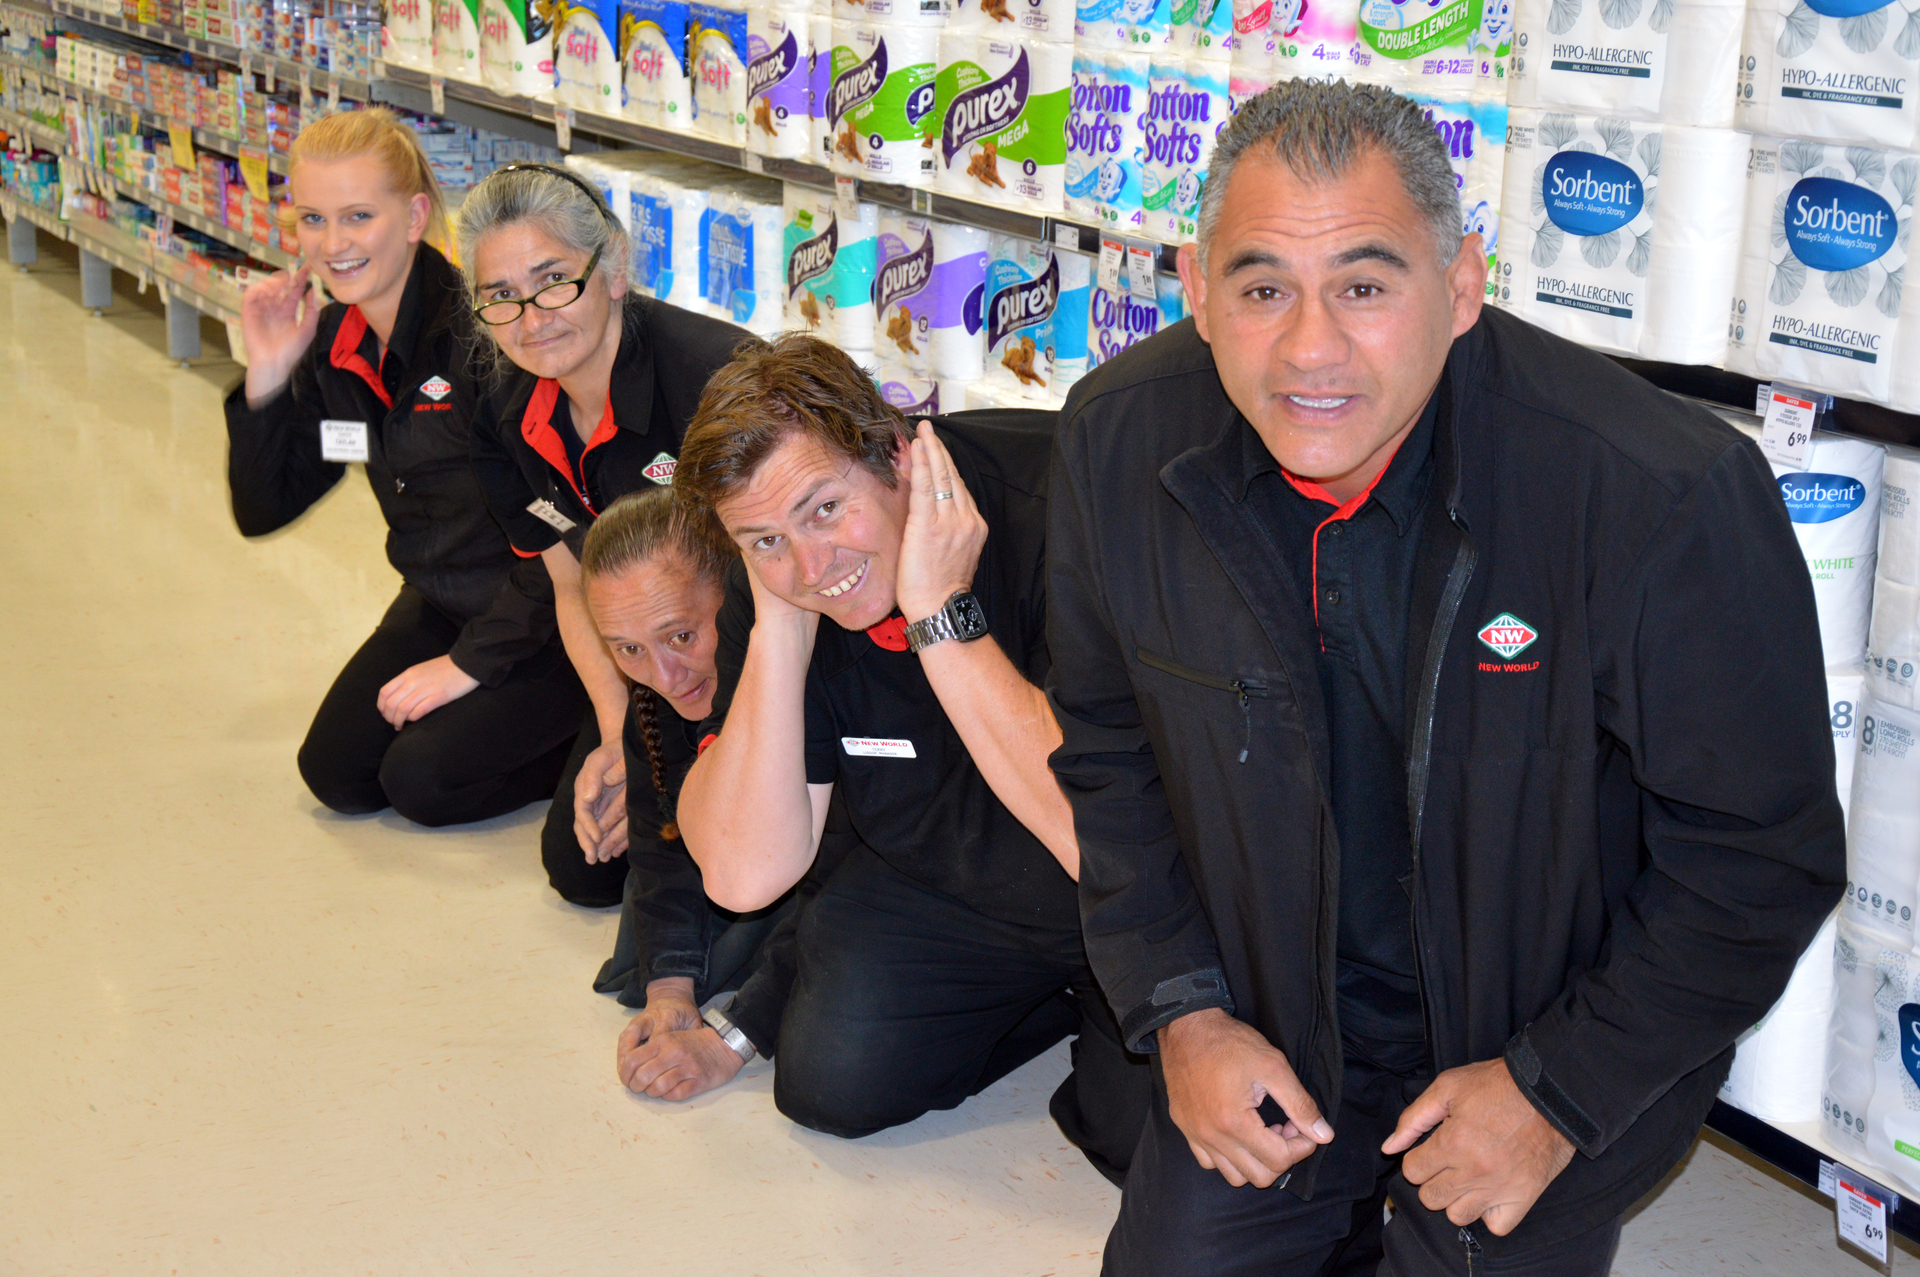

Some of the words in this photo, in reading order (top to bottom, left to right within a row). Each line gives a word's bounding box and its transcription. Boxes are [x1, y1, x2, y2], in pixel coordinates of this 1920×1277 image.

[1378, 25, 1421, 50] DOUBLE
[1422, 1, 1469, 40] LENGTH
[566, 33, 598, 64] Soft
[1312, 43, 1325, 60] 4
[1553, 43, 1653, 65] HYPO-ALLERGENIC
[633, 49, 663, 81] Soft
[701, 57, 731, 92] Soft
[748, 50, 786, 97] purex
[1582, 64, 1590, 72] DYE
[1594, 66, 1619, 75] FRAGRANCE
[835, 60, 878, 115] purex
[1782, 68, 1907, 95] HYPO-ALLERGENIC
[1148, 84, 1210, 122] otton
[1812, 91, 1822, 99] DYE
[1828, 93, 1863, 103] FRAGRANCE
[1864, 96, 1878, 104] FREE
[778, 108, 785, 118] 4
[952, 77, 1018, 148] purex
[986, 116, 1010, 133] SOFTNESS
[998, 119, 1029, 148] MEGA
[1066, 112, 1122, 157] Softs
[872, 137, 879, 148] 4
[1144, 122, 1201, 167] Softs
[1026, 161, 1033, 174] 6
[1550, 167, 1632, 205] Sorbent
[1553, 199, 1573, 211] Always
[1573, 201, 1585, 211] Soft
[1587, 204, 1606, 216] Always
[1606, 206, 1626, 219] Strong
[1793, 195, 1884, 238] Sorbent
[1796, 230, 1817, 243] Always
[1817, 232, 1830, 243] Soft
[1833, 235, 1855, 249] Always
[1856, 238, 1877, 252] Strong
[794, 234, 833, 286] purex
[882, 252, 928, 305] purex
[1537, 276, 1634, 306] HYPO-ALLERGENIC
[997, 278, 1052, 335] purex
[1092, 288, 1158, 335] Cotton
[1600, 306, 1610, 314] FREE
[920, 319, 928, 331] 12
[1772, 315, 1881, 350] HYPO-ALLERGENIC
[1800, 340, 1809, 348] DYE
[1813, 342, 1842, 355] FRAGRANCE
[1842, 349, 1854, 357] FREE
[427, 383, 446, 392] NW
[432, 403, 452, 411] WOR
[652, 464, 676, 476] NW
[1781, 482, 1856, 502] Sorbent
[1893, 493, 1911, 505] ROLLS
[1817, 502, 1835, 510] Always
[1813, 557, 1855, 570] WHITE
[1490, 630, 1525, 644] NW
[1478, 662, 1501, 672] NEW
[1503, 661, 1540, 672] WORLD
[1831, 700, 1853, 729] 8
[1862, 715, 1876, 745] 8
[1880, 720, 1911, 737] EMBOSSED
[1880, 728, 1897, 739] LONG
[1896, 734, 1915, 746] ROLLS
[1889, 740, 1909, 753] SHEETS
[1902, 1145, 1920, 1160] PERFEC
